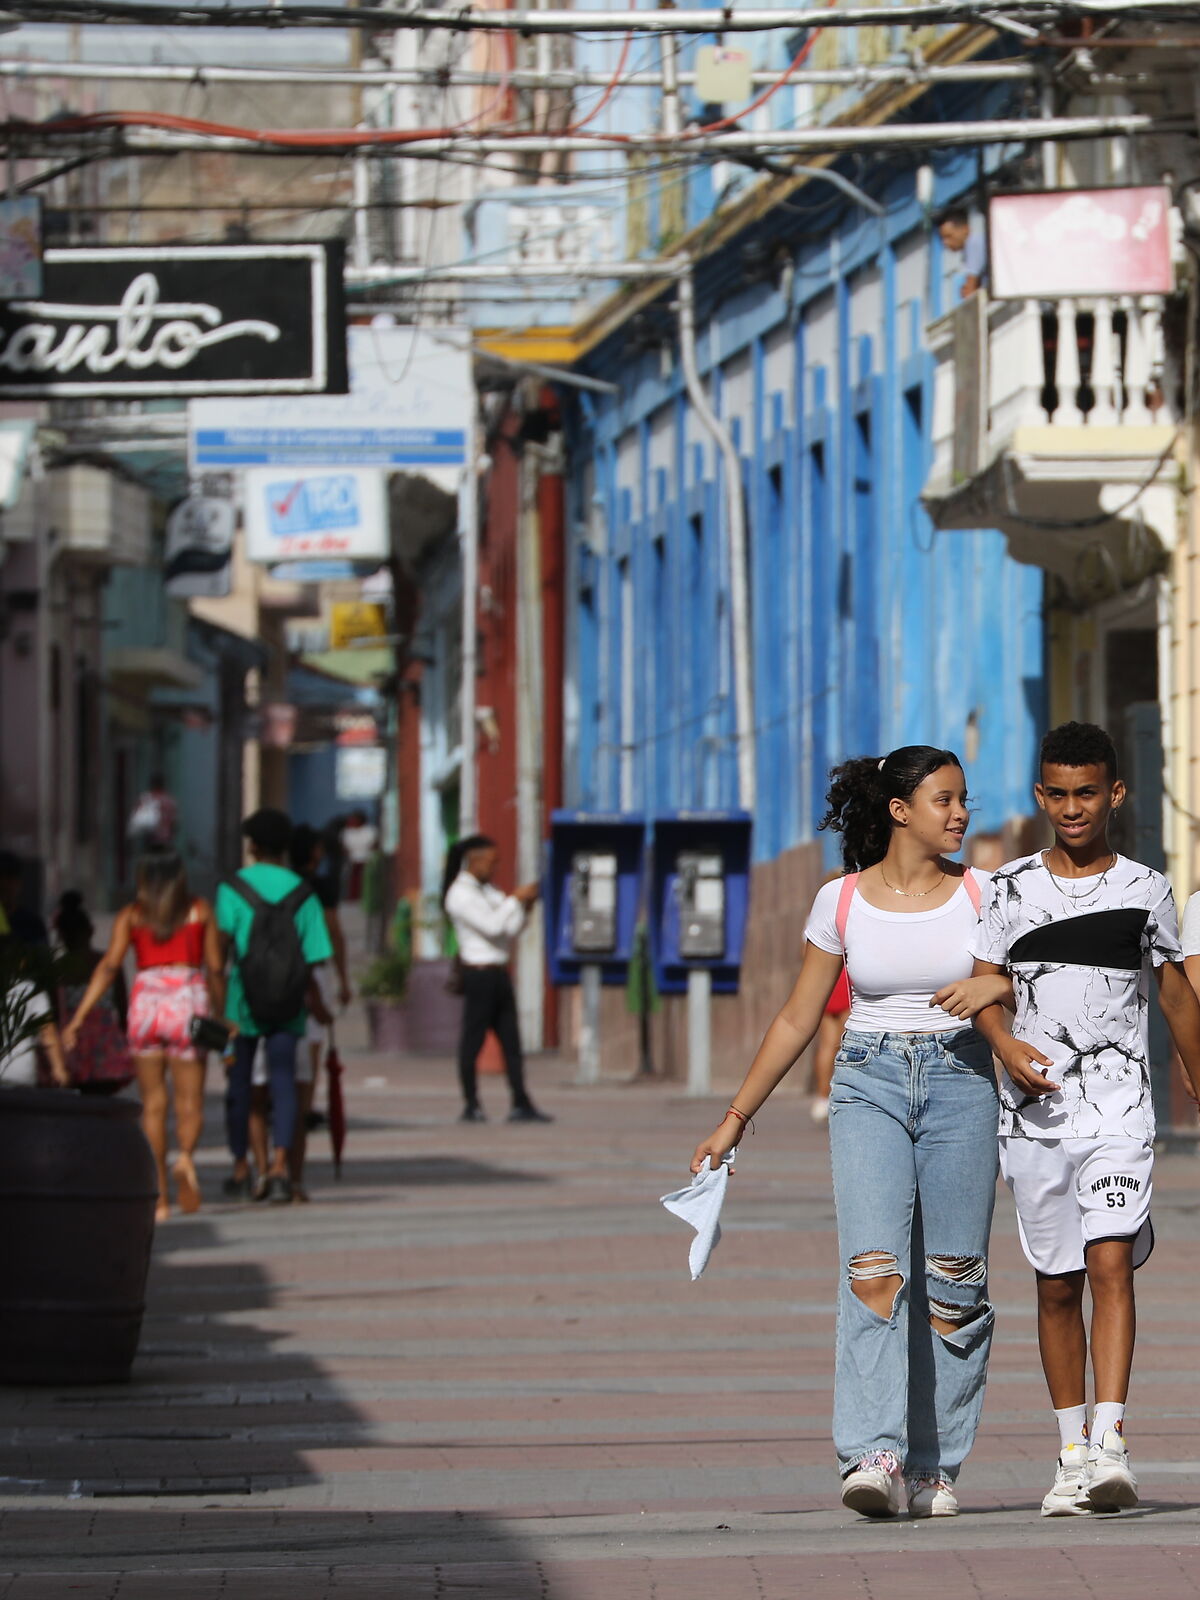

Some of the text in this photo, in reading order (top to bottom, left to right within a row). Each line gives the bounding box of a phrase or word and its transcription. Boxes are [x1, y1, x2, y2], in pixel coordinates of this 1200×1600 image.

[0, 271, 280, 374] anto
[1090, 1175, 1141, 1195] NEW YORK
[1106, 1191, 1126, 1208] 53
